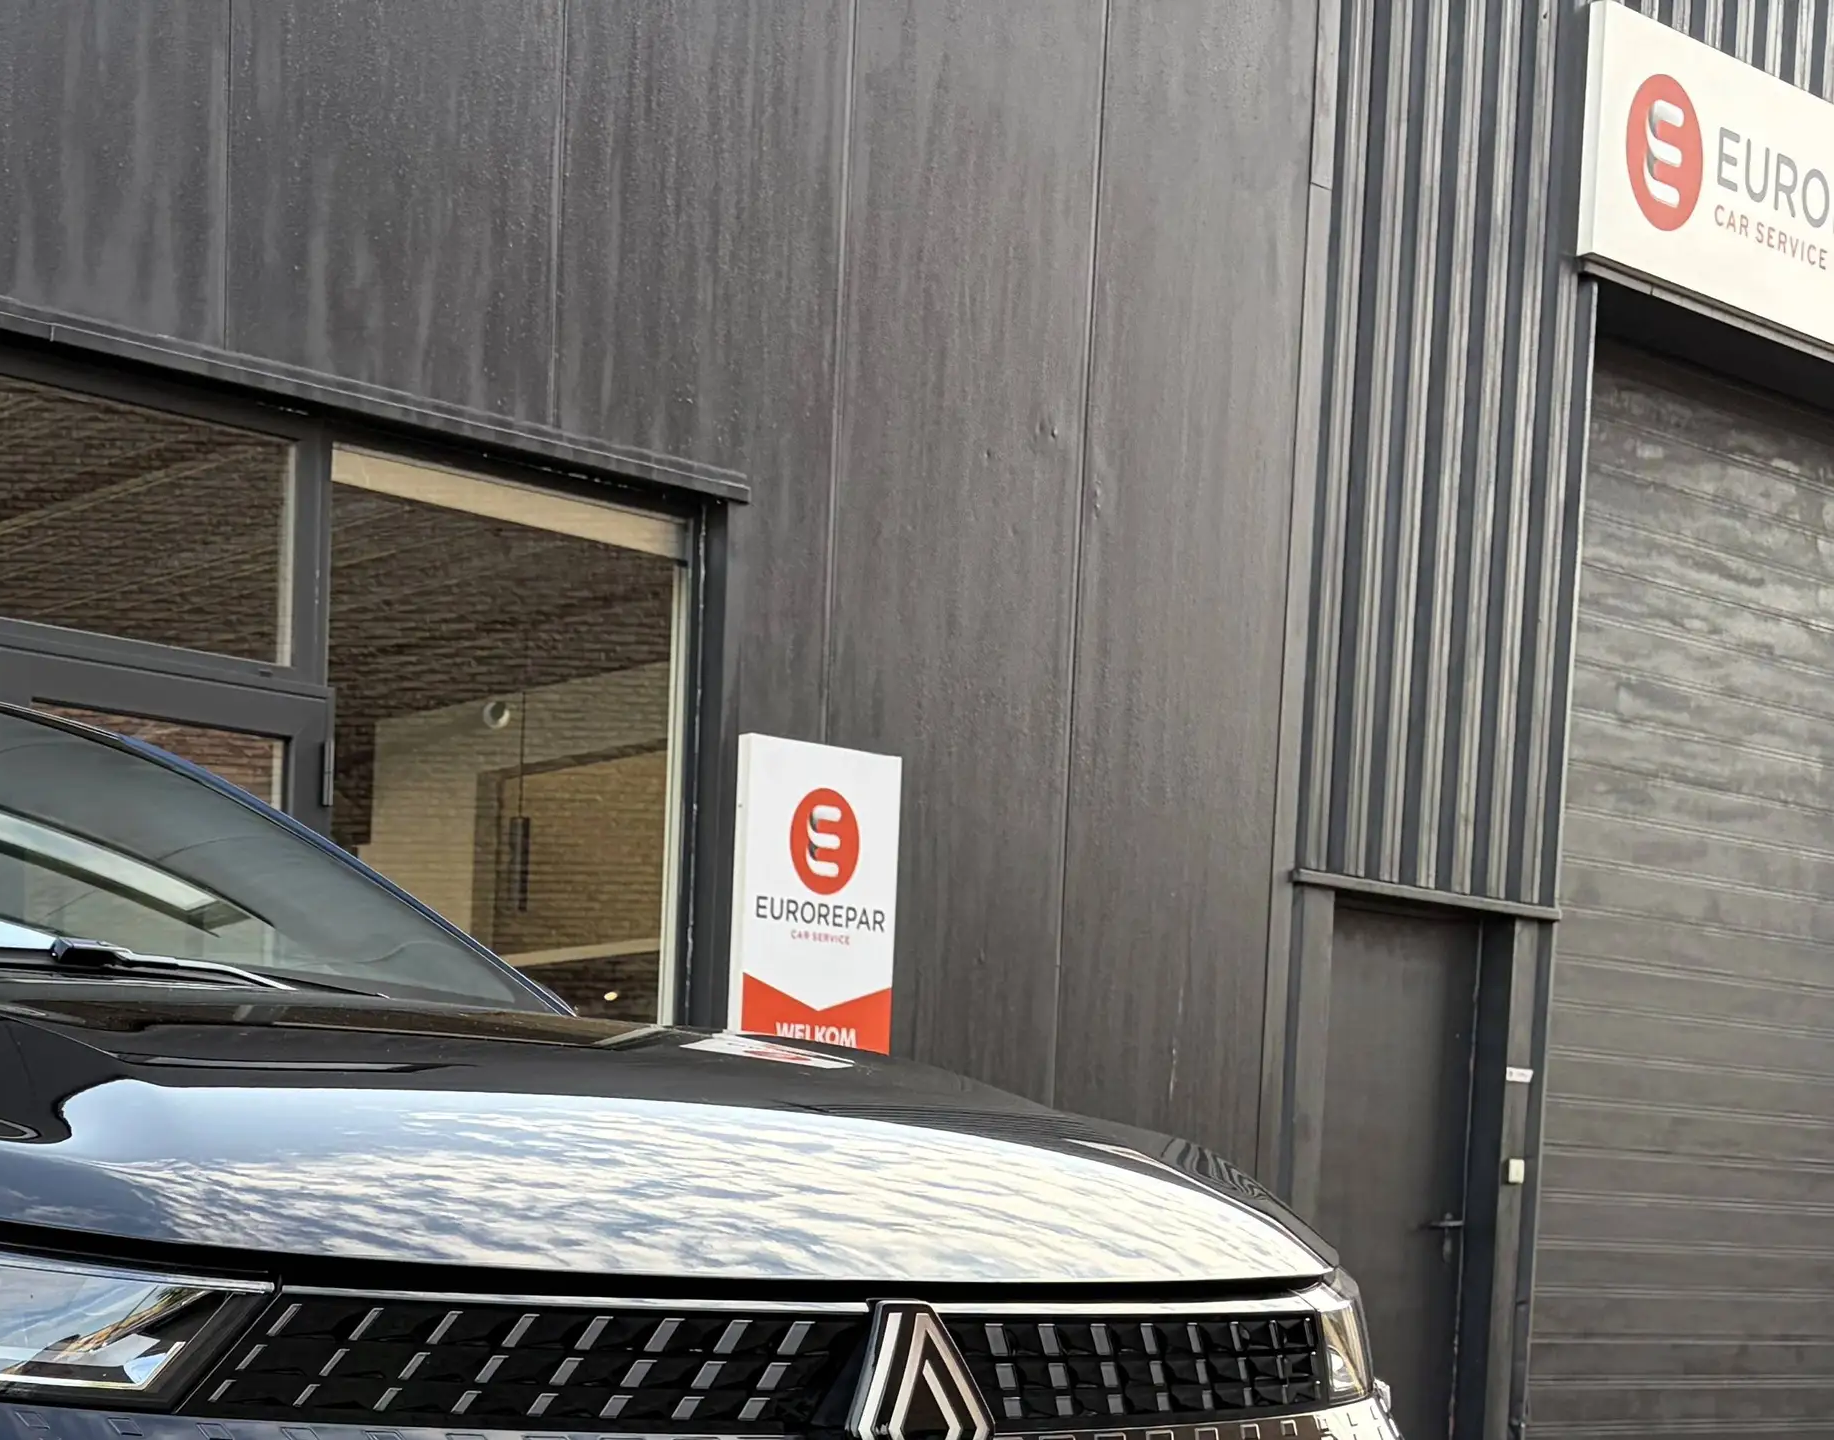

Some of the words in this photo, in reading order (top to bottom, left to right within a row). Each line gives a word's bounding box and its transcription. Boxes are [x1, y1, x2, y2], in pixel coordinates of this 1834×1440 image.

[1716, 126, 1834, 229] EURO
[1714, 204, 1749, 239] CAR
[1755, 221, 1828, 271] SERVICE
[755, 895, 886, 933] EUROREPAR
[790, 929, 810, 940] CAR
[812, 931, 851, 945] SERVICE
